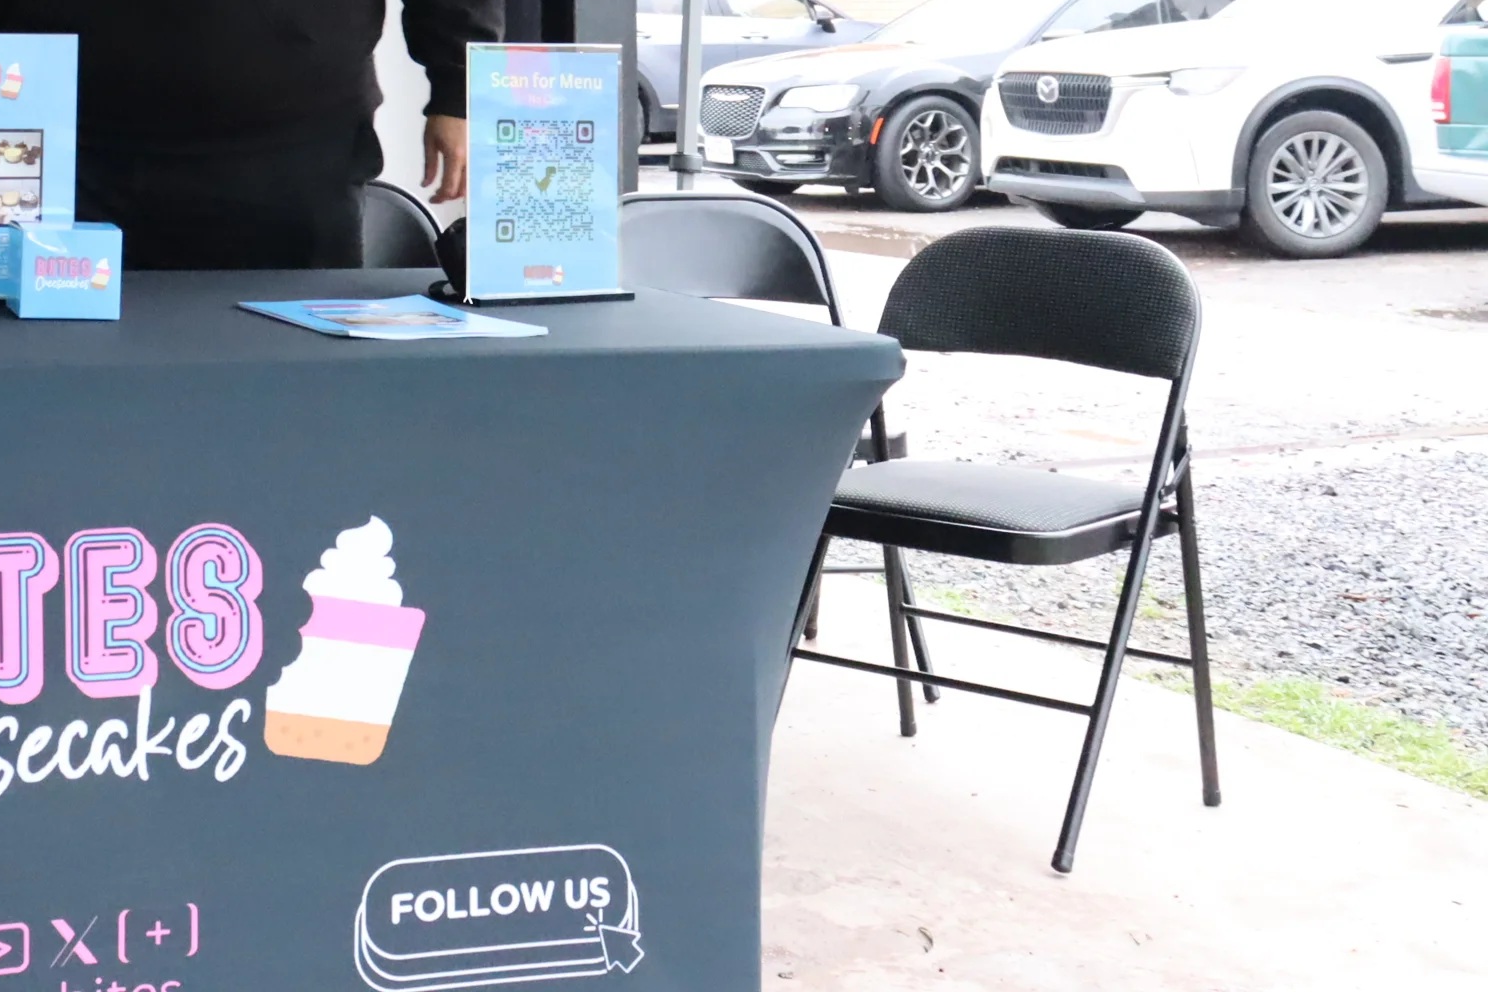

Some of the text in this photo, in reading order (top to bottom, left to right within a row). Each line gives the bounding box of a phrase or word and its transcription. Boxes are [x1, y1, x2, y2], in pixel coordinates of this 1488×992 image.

[490, 71, 603, 90] Scan for Menu
[35, 255, 92, 279] BITES
[391, 876, 611, 925] FOLLOW US
